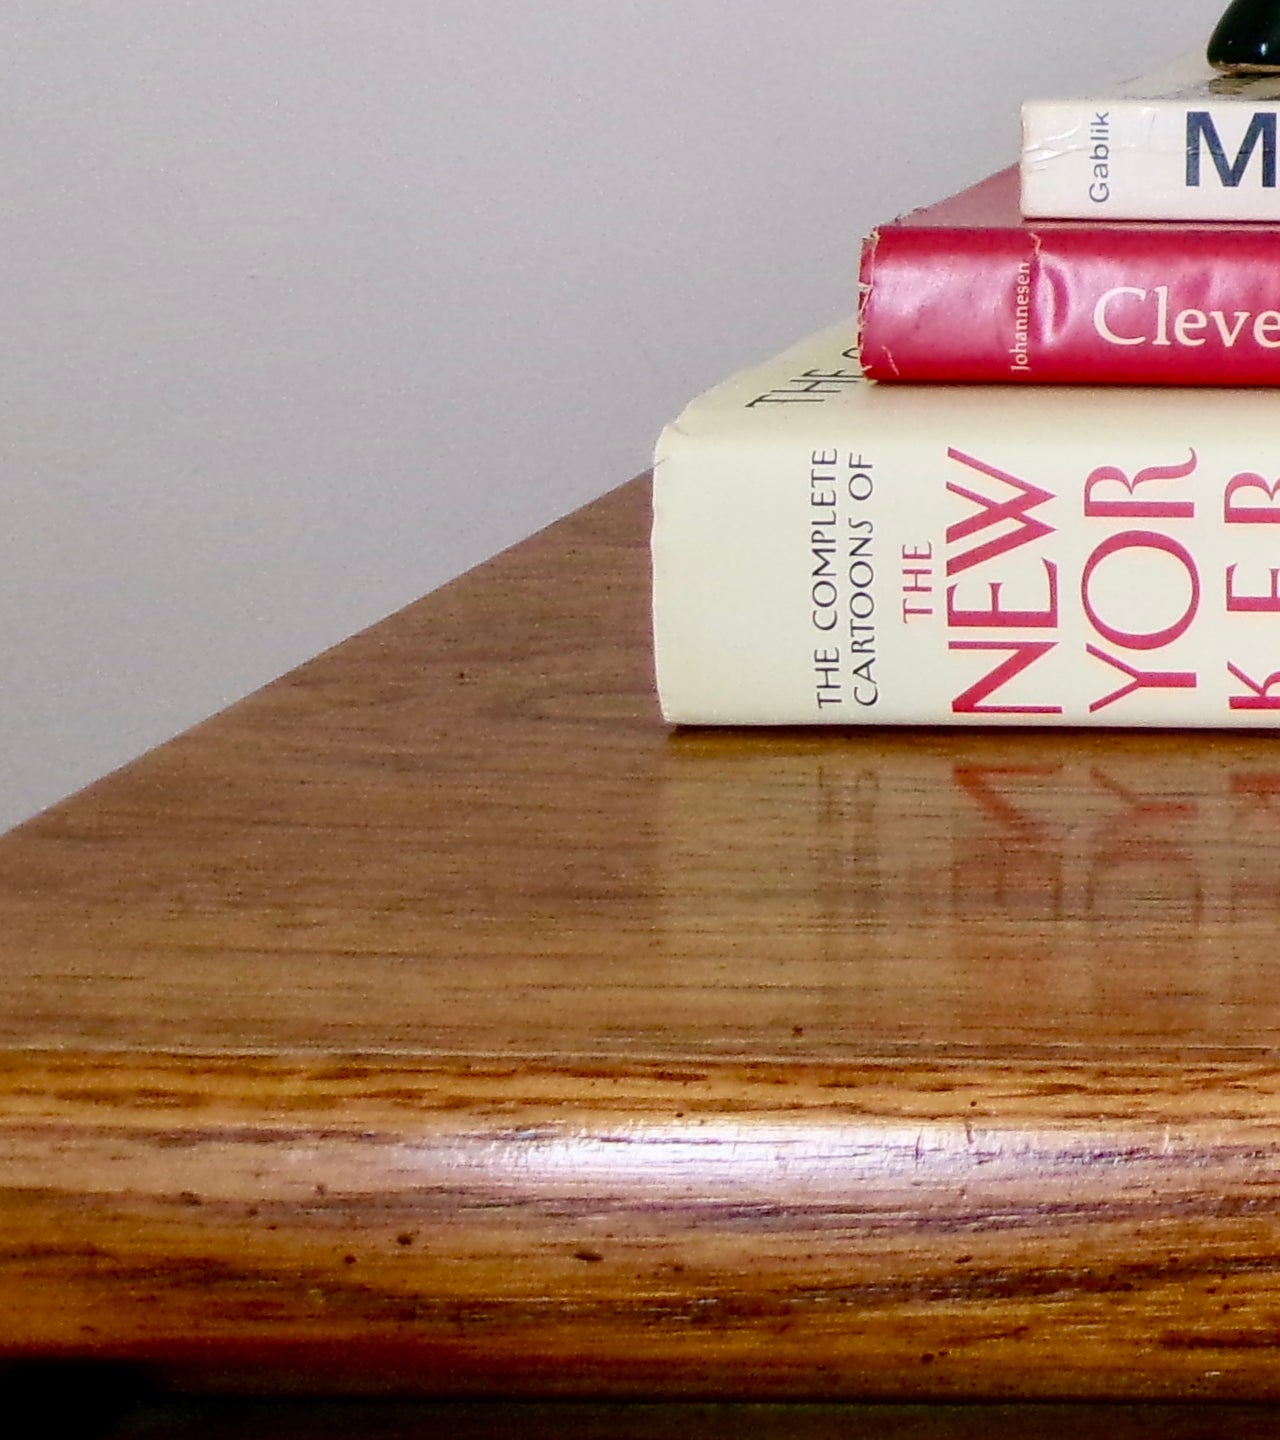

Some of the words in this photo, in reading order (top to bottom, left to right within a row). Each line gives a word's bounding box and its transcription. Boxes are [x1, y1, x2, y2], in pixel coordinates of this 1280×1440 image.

[1088, 111, 1110, 203] Gablik
[1008, 262, 1031, 371] Johannesen
[848, 452, 874, 501] OF
[810, 448, 838, 632] COMPLETE
[901, 541, 933, 624] THE
[945, 446, 1063, 714] NEW
[1080, 446, 1201, 713] YOR
[848, 517, 880, 707] CARTOONS
[814, 646, 843, 710] THE
